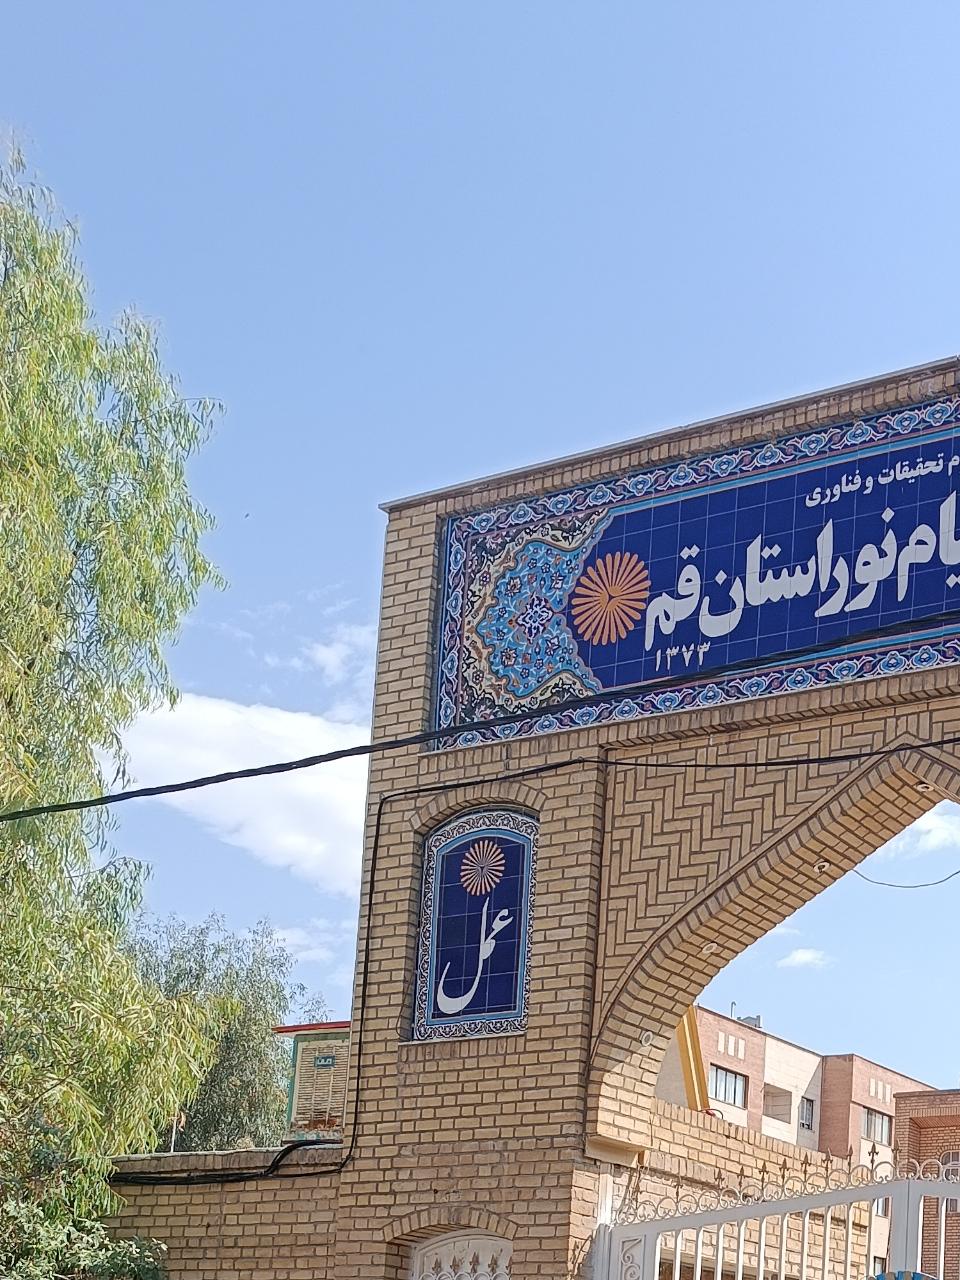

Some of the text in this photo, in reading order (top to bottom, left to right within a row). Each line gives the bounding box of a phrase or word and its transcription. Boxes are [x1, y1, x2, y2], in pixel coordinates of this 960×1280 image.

[805, 469, 862, 508] فناوری
[862, 475, 874, 495] و
[877, 453, 944, 485] تحقیقات
[699, 519, 834, 638] استان
[814, 507, 899, 618] نور
[644, 544, 701, 652] قم
[655, 641, 711, 672] ۱۳۷۳
